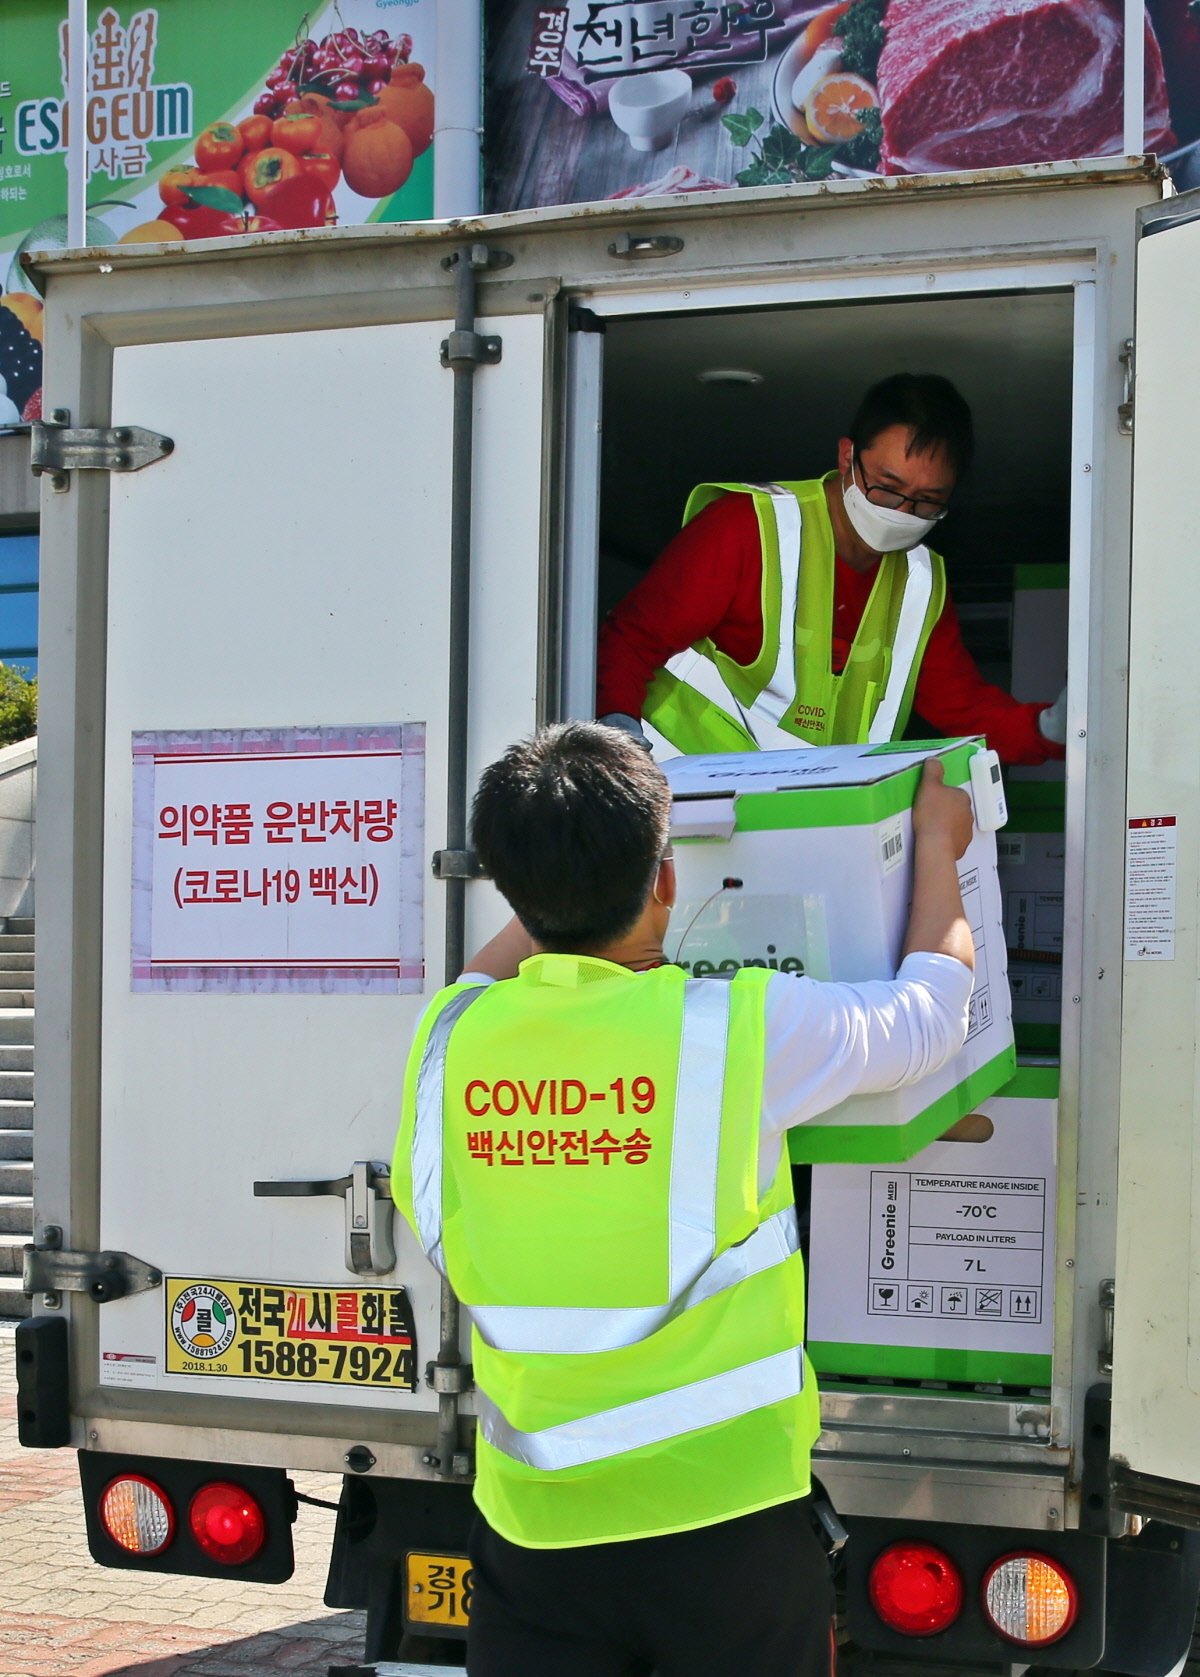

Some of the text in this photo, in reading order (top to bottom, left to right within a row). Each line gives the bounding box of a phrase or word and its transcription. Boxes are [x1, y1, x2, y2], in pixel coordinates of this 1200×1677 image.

[527, 10, 568, 77] 경주
[573, 0, 786, 68] 천년한우
[86, 144, 147, 179] 사금
[158, 799, 398, 846] 의약품 운반차량
[173, 863, 379, 909] (코로나19 백신)
[464, 1076, 656, 1117] COVID-19
[466, 1128, 652, 1167] 백신안전수송
[915, 1178, 1040, 1192] TEMPERATURE RANGE INSIDE
[881, 1181, 897, 1271] Greenie MEDI
[935, 1233, 1017, 1244] PAYLOAD IN LITERS
[964, 1259, 987, 1272] 7 L
[197, 1308, 213, 1333] 콜
[182, 1361, 228, 1373] 2018.1.30
[237, 1339, 413, 1384] 1588-7924
